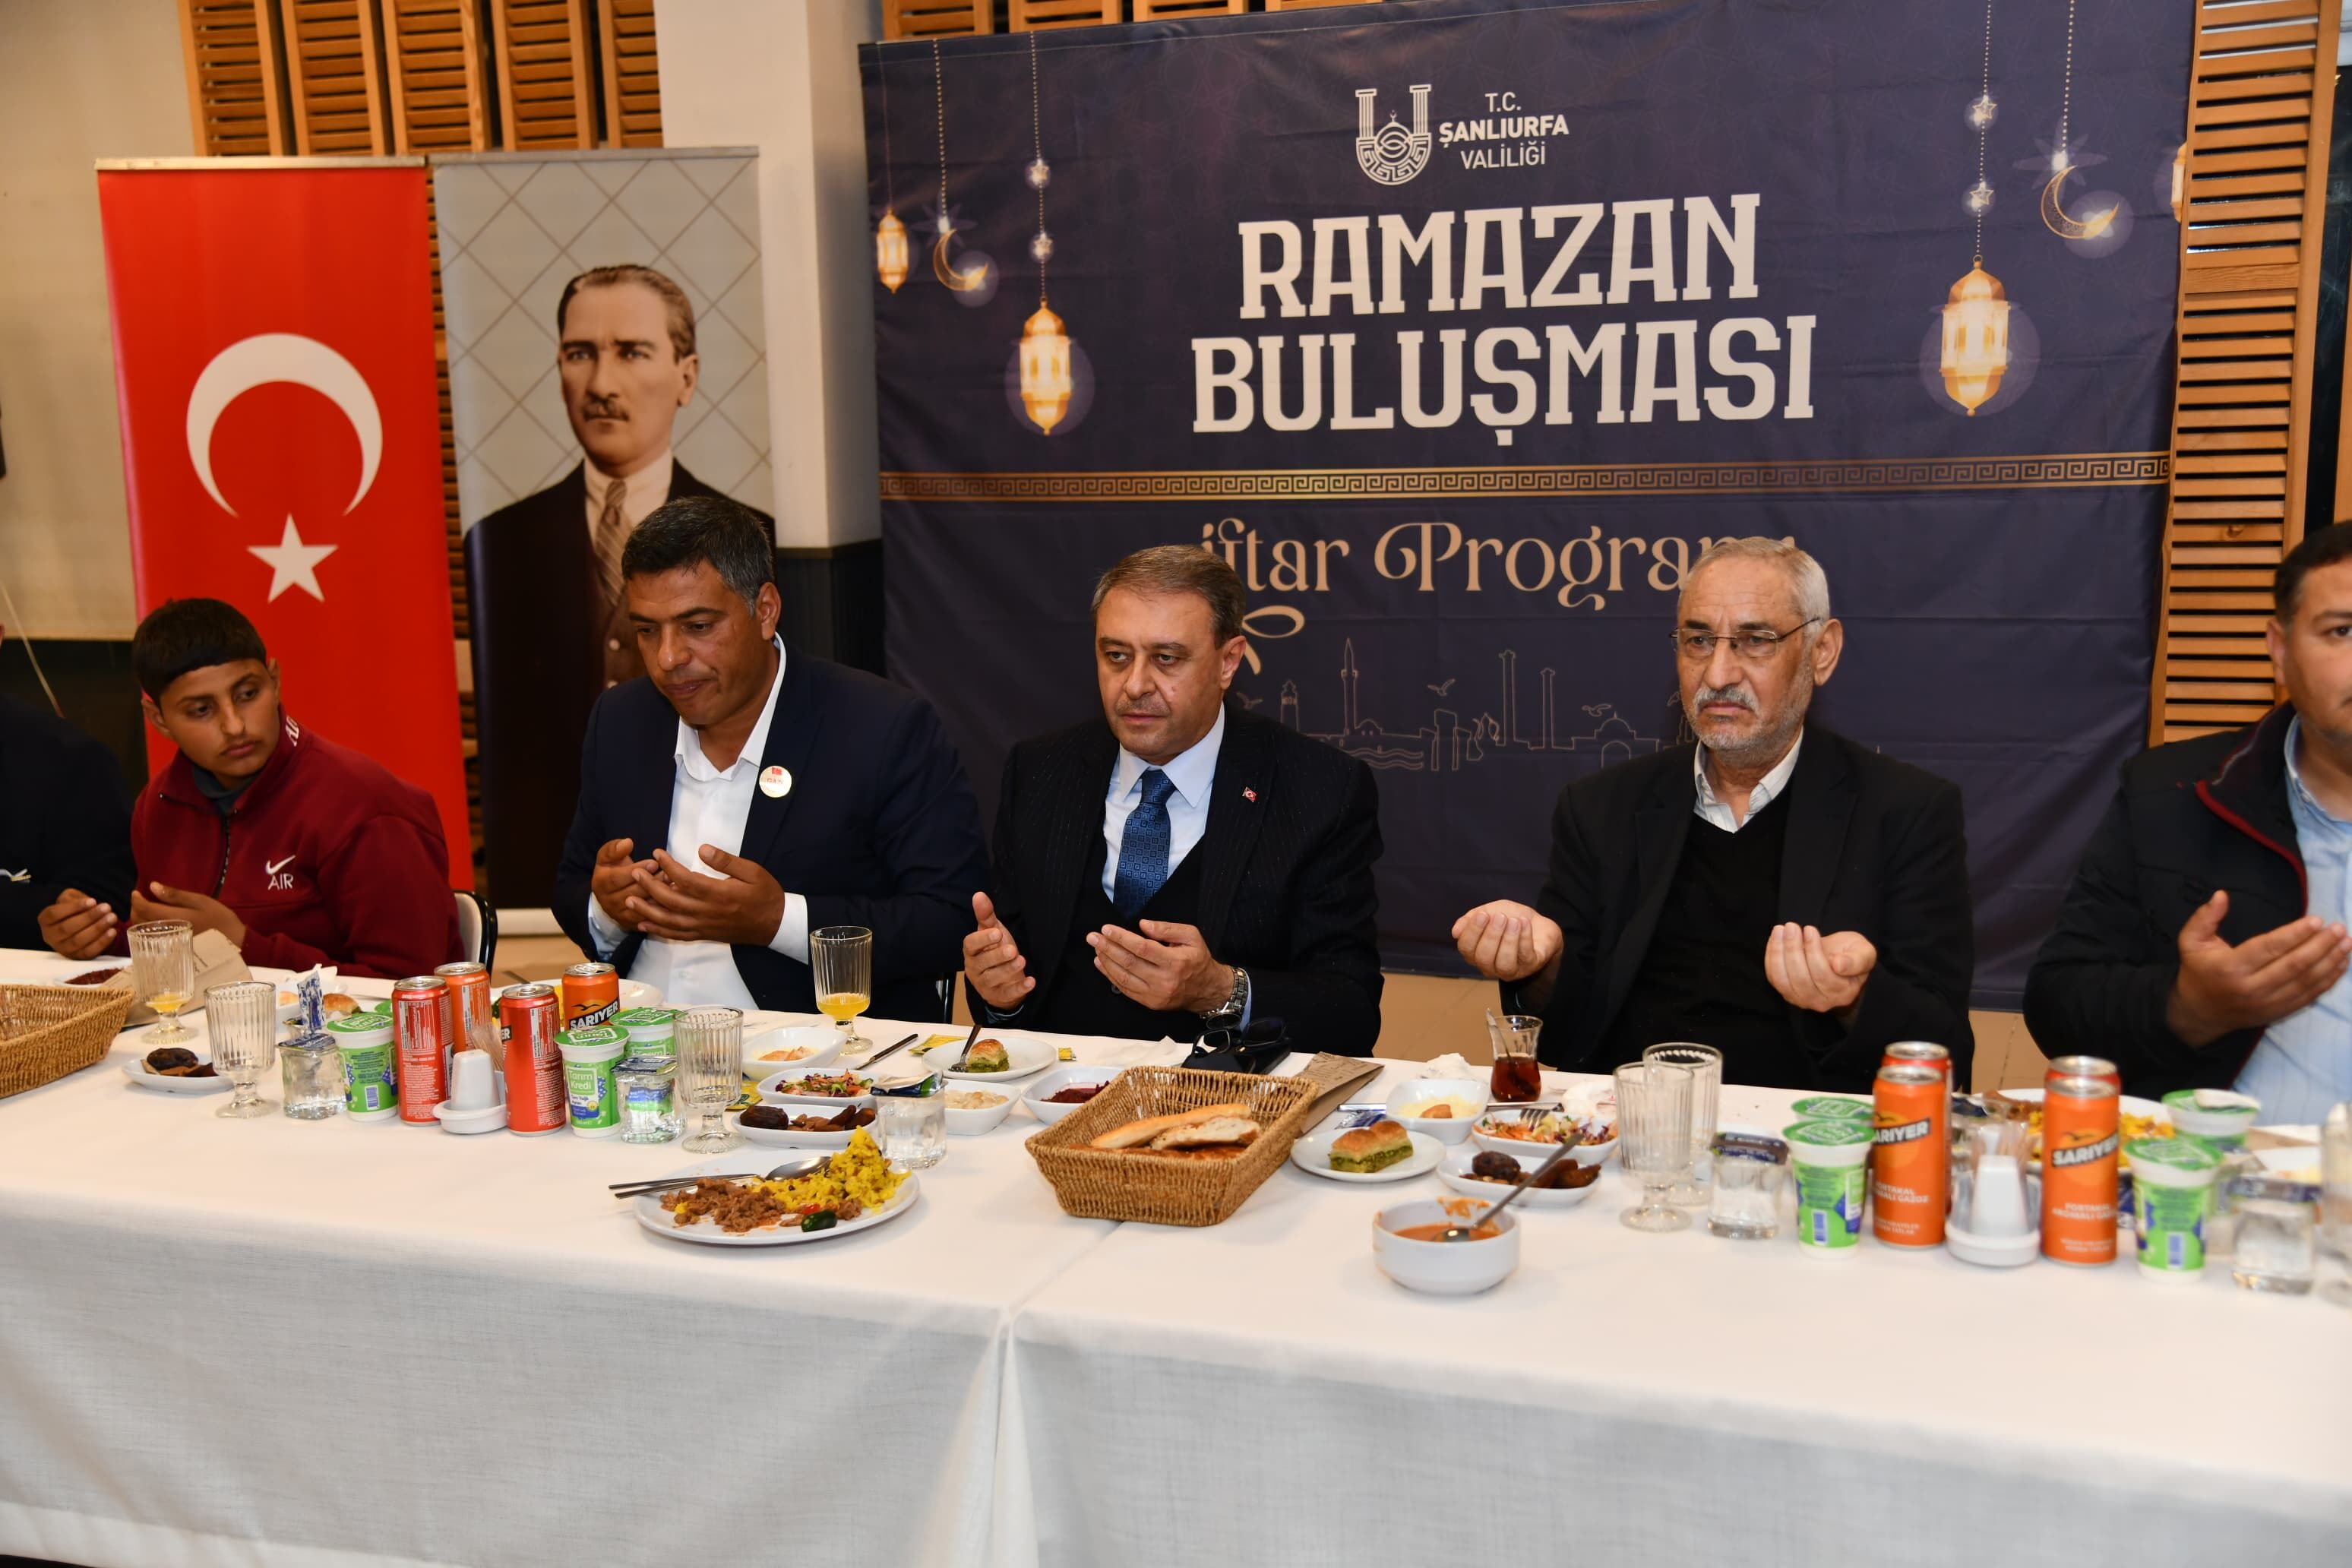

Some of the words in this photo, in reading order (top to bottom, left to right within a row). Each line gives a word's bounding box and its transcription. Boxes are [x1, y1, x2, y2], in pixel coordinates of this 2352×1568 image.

[1484, 91, 1522, 112] T.C.
[1438, 114, 1570, 148] ŞANLIURFA
[1460, 141, 1546, 169] VALİLİĞİ
[1238, 193, 1760, 319] RAMAZAN
[1191, 315, 1816, 446] BULUŞMASI
[1374, 522, 1795, 611] Progra
[267, 873, 294, 890] AIR
[570, 1001, 618, 1029] SARIYER
[1875, 1121, 1928, 1143] ARIYER
